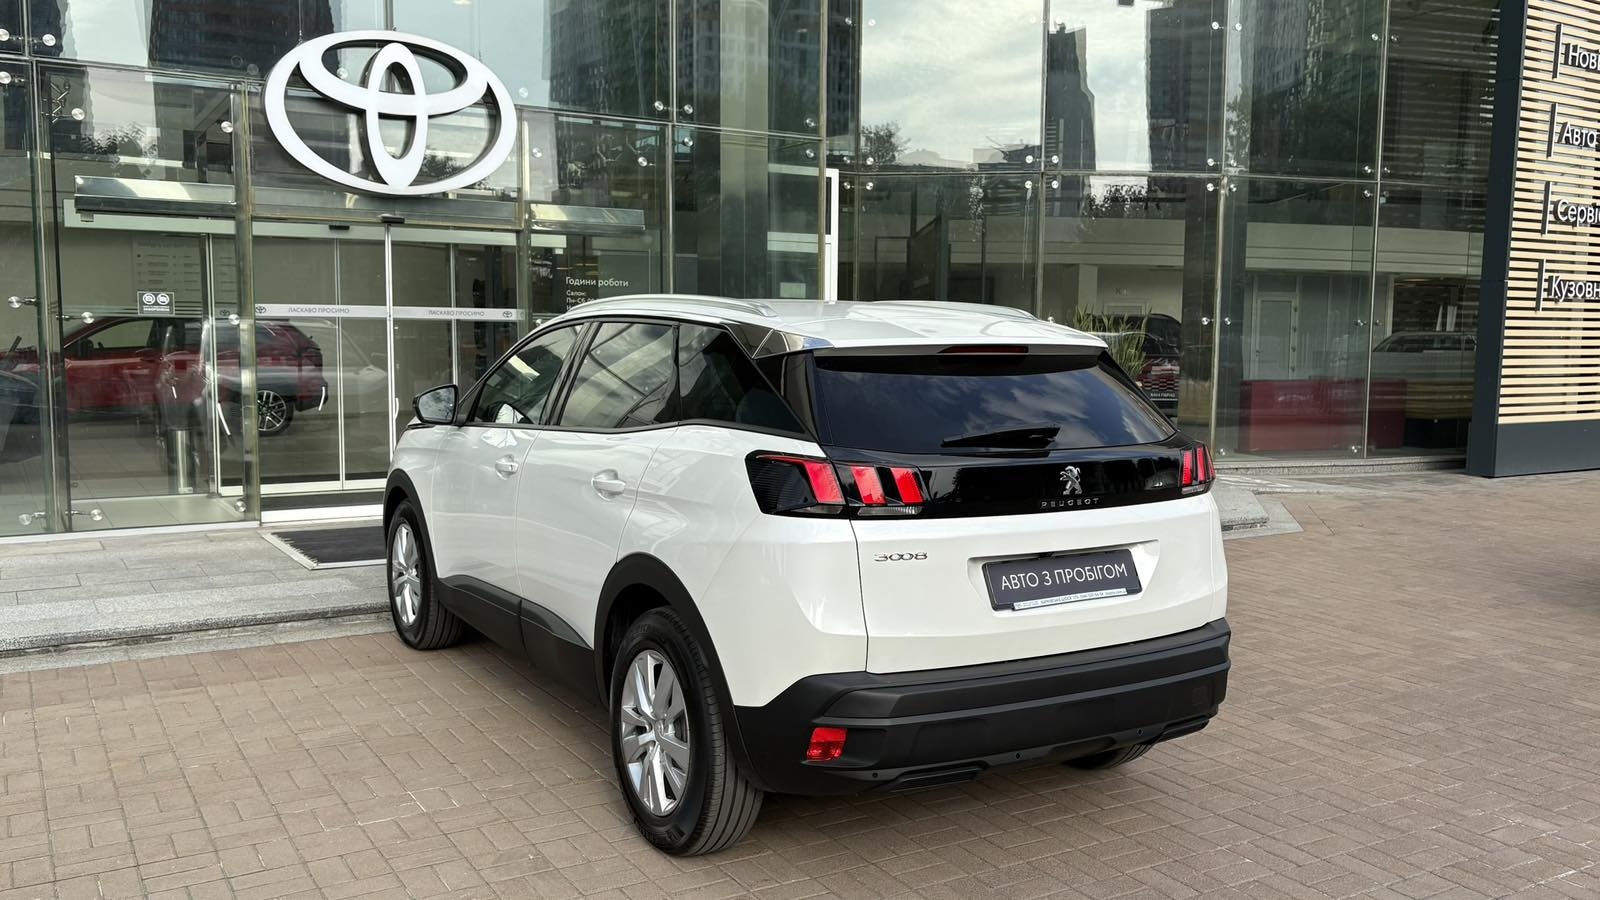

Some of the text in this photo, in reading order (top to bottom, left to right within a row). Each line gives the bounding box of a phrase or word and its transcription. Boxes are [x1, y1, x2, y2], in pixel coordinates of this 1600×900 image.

[1561, 120, 1597, 148] Авто
[1556, 199, 1600, 227] Серві
[565, 276, 629, 288] Години роботи
[1041, 497, 1100, 508] PEUGEOT
[873, 551, 928, 562] 3008
[1001, 572, 1039, 591] АВТО
[1054, 563, 1128, 585] ПРОБІГОМ
